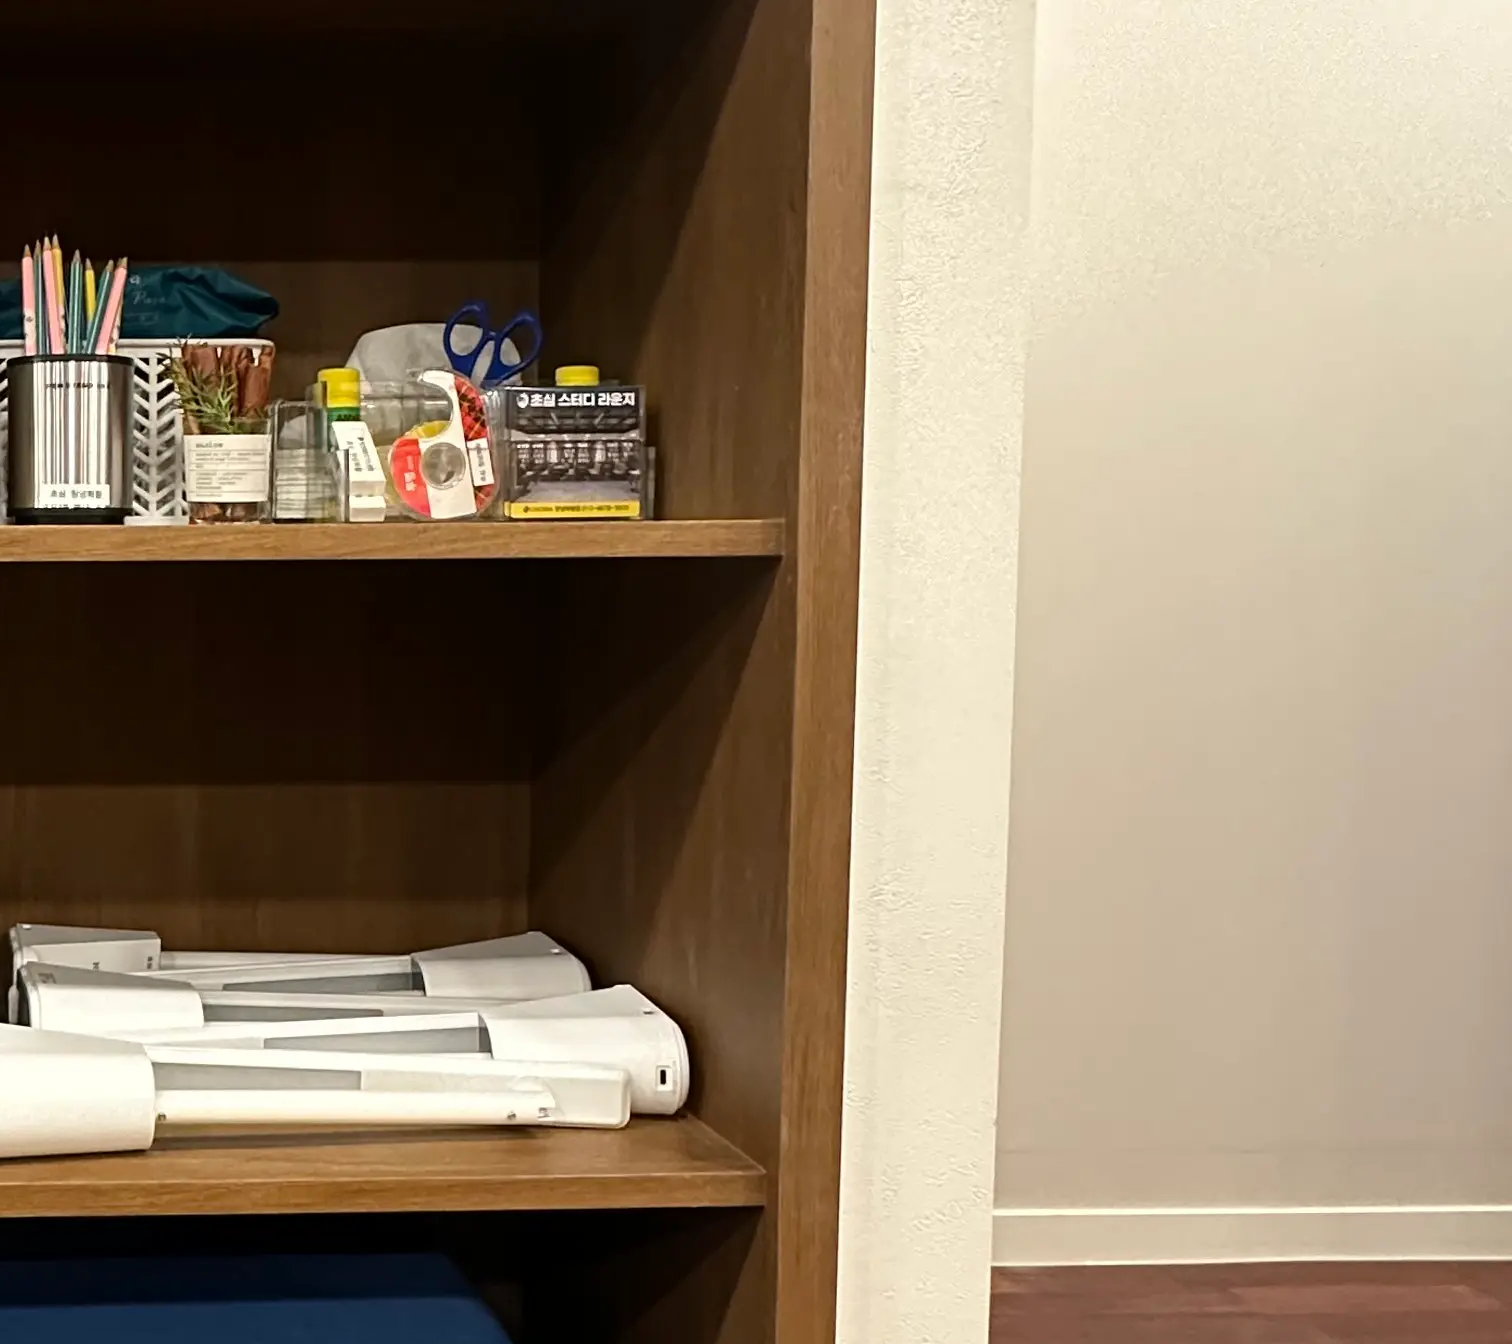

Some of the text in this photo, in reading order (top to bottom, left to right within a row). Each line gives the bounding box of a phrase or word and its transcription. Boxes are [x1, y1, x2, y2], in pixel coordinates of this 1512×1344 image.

[530, 392, 636, 407] 초심 스터디 라운지
